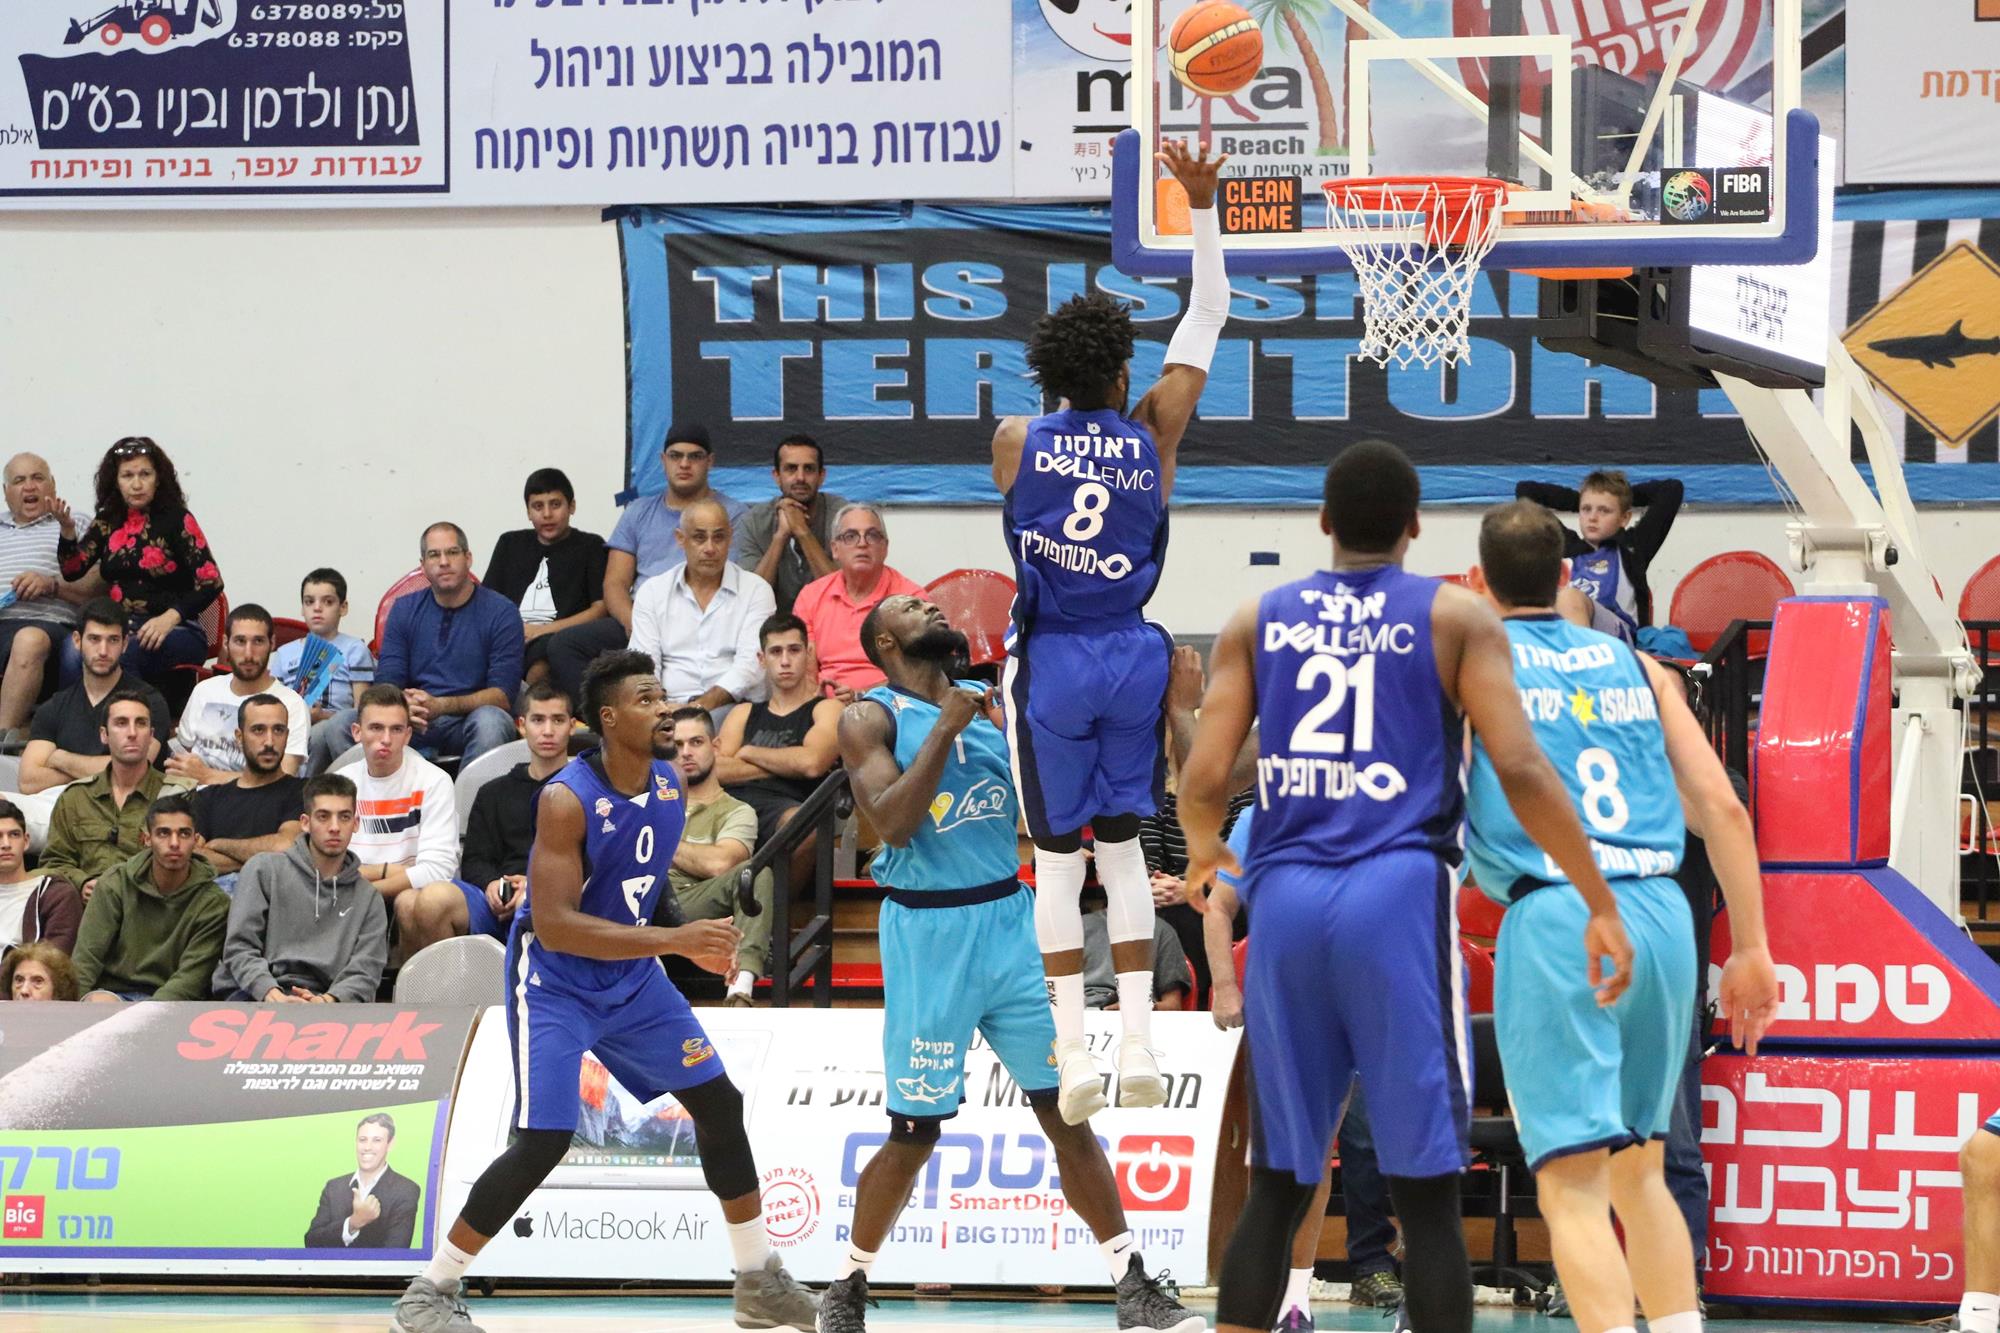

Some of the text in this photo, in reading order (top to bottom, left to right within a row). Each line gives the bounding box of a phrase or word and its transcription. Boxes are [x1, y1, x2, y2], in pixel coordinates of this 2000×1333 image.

[227, 30, 403, 50] פקס: 6378088
[530, 34, 942, 89] המובילה בביצוע וניהול
[157, 87, 228, 137] ובניו
[243, 71, 341, 141] ולדמן
[357, 85, 409, 140] נתן
[475, 120, 1000, 173] עבודות בנייה תשתיות ופיתוח
[1221, 136, 1304, 155] Beach
[30, 156, 423, 180] עבודות עפר, בניה ופיתוח
[1723, 174, 1762, 193] FIBA
[1227, 180, 1293, 204] CLEAN
[1226, 205, 1293, 231] GAME
[692, 261, 1006, 324] THIS
[1063, 482, 1110, 541] 8
[1021, 530, 1099, 575] מטרופולין
[1289, 653, 1376, 754] 21
[1576, 747, 1629, 833] 8
[636, 826, 655, 864] 0
[176, 1009, 443, 1061] Shark
[223, 1060, 425, 1076] השואב עם המברשת הכפולה
[243, 1075, 420, 1091] גם לשטיחים וגם לרצפות
[764, 1196, 800, 1211] TAX
[766, 1208, 805, 1225] FREE
[57, 1215, 113, 1239] מרכז
[543, 1211, 709, 1241] MacBook Air
[955, 1226, 1045, 1244] מרכז BIG
[1142, 1228, 1185, 1251] קניון
[1744, 1245, 1900, 1279] הפתרונות
[1911, 1244, 1954, 1281] כל
